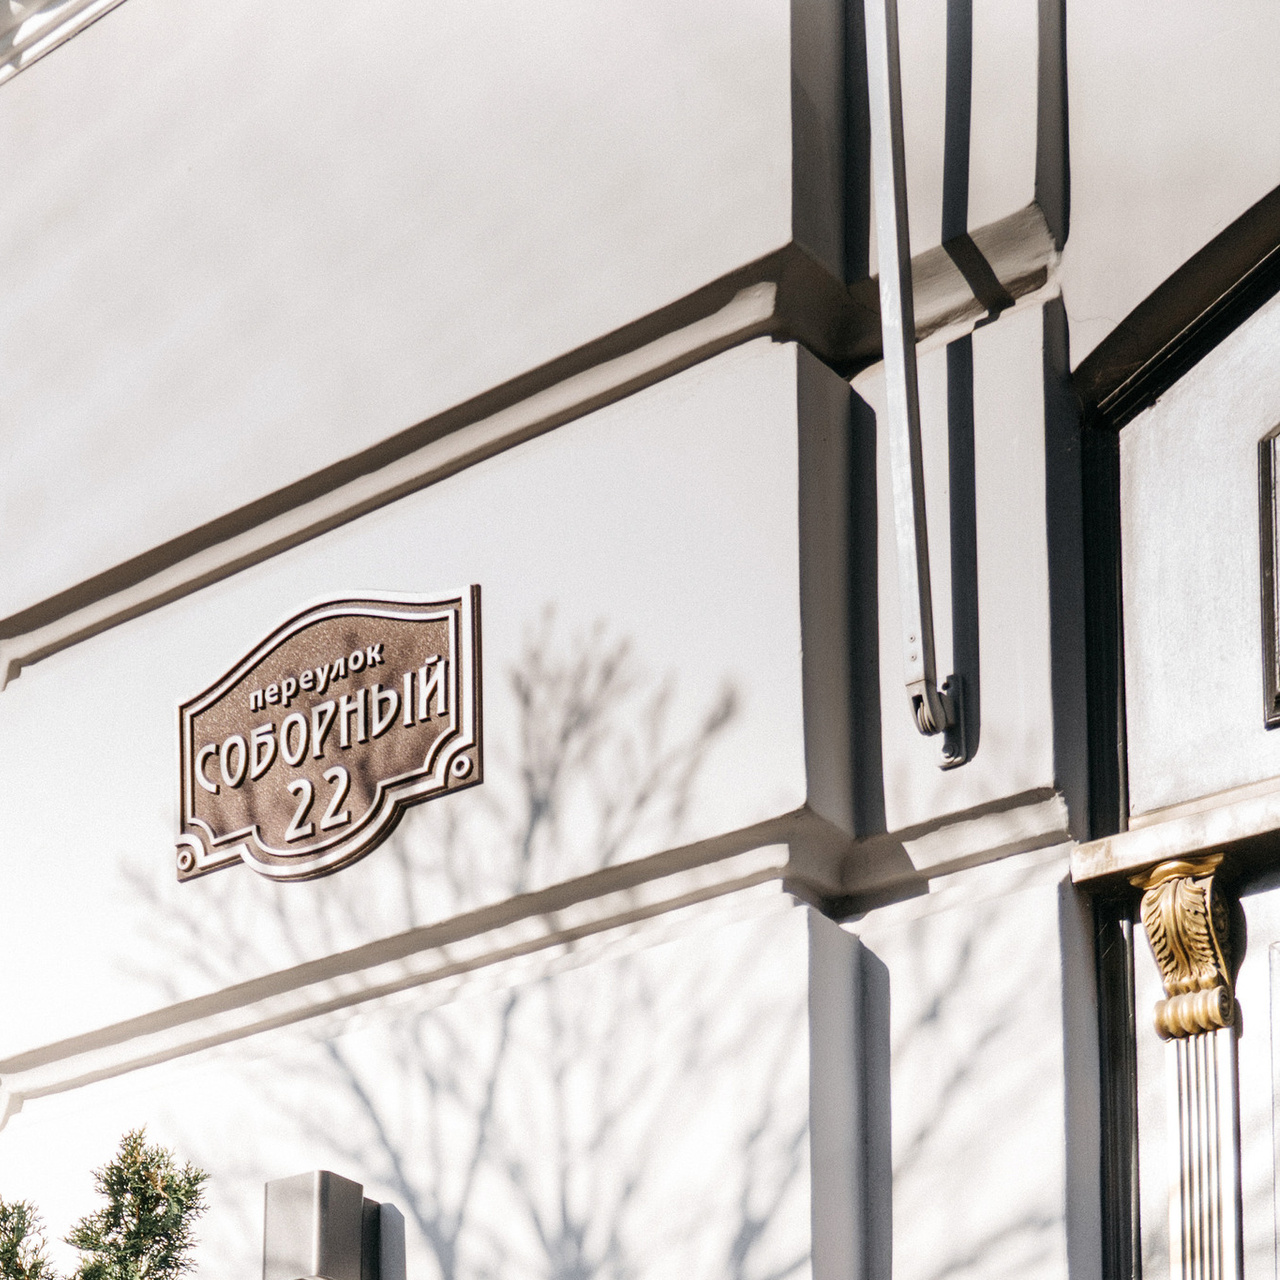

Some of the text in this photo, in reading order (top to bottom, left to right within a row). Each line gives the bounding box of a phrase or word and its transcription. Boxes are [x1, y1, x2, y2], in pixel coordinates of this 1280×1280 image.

[249, 644, 384, 711] переулок
[195, 655, 449, 794] СОБОРНЫЙ
[285, 766, 352, 842] 22
